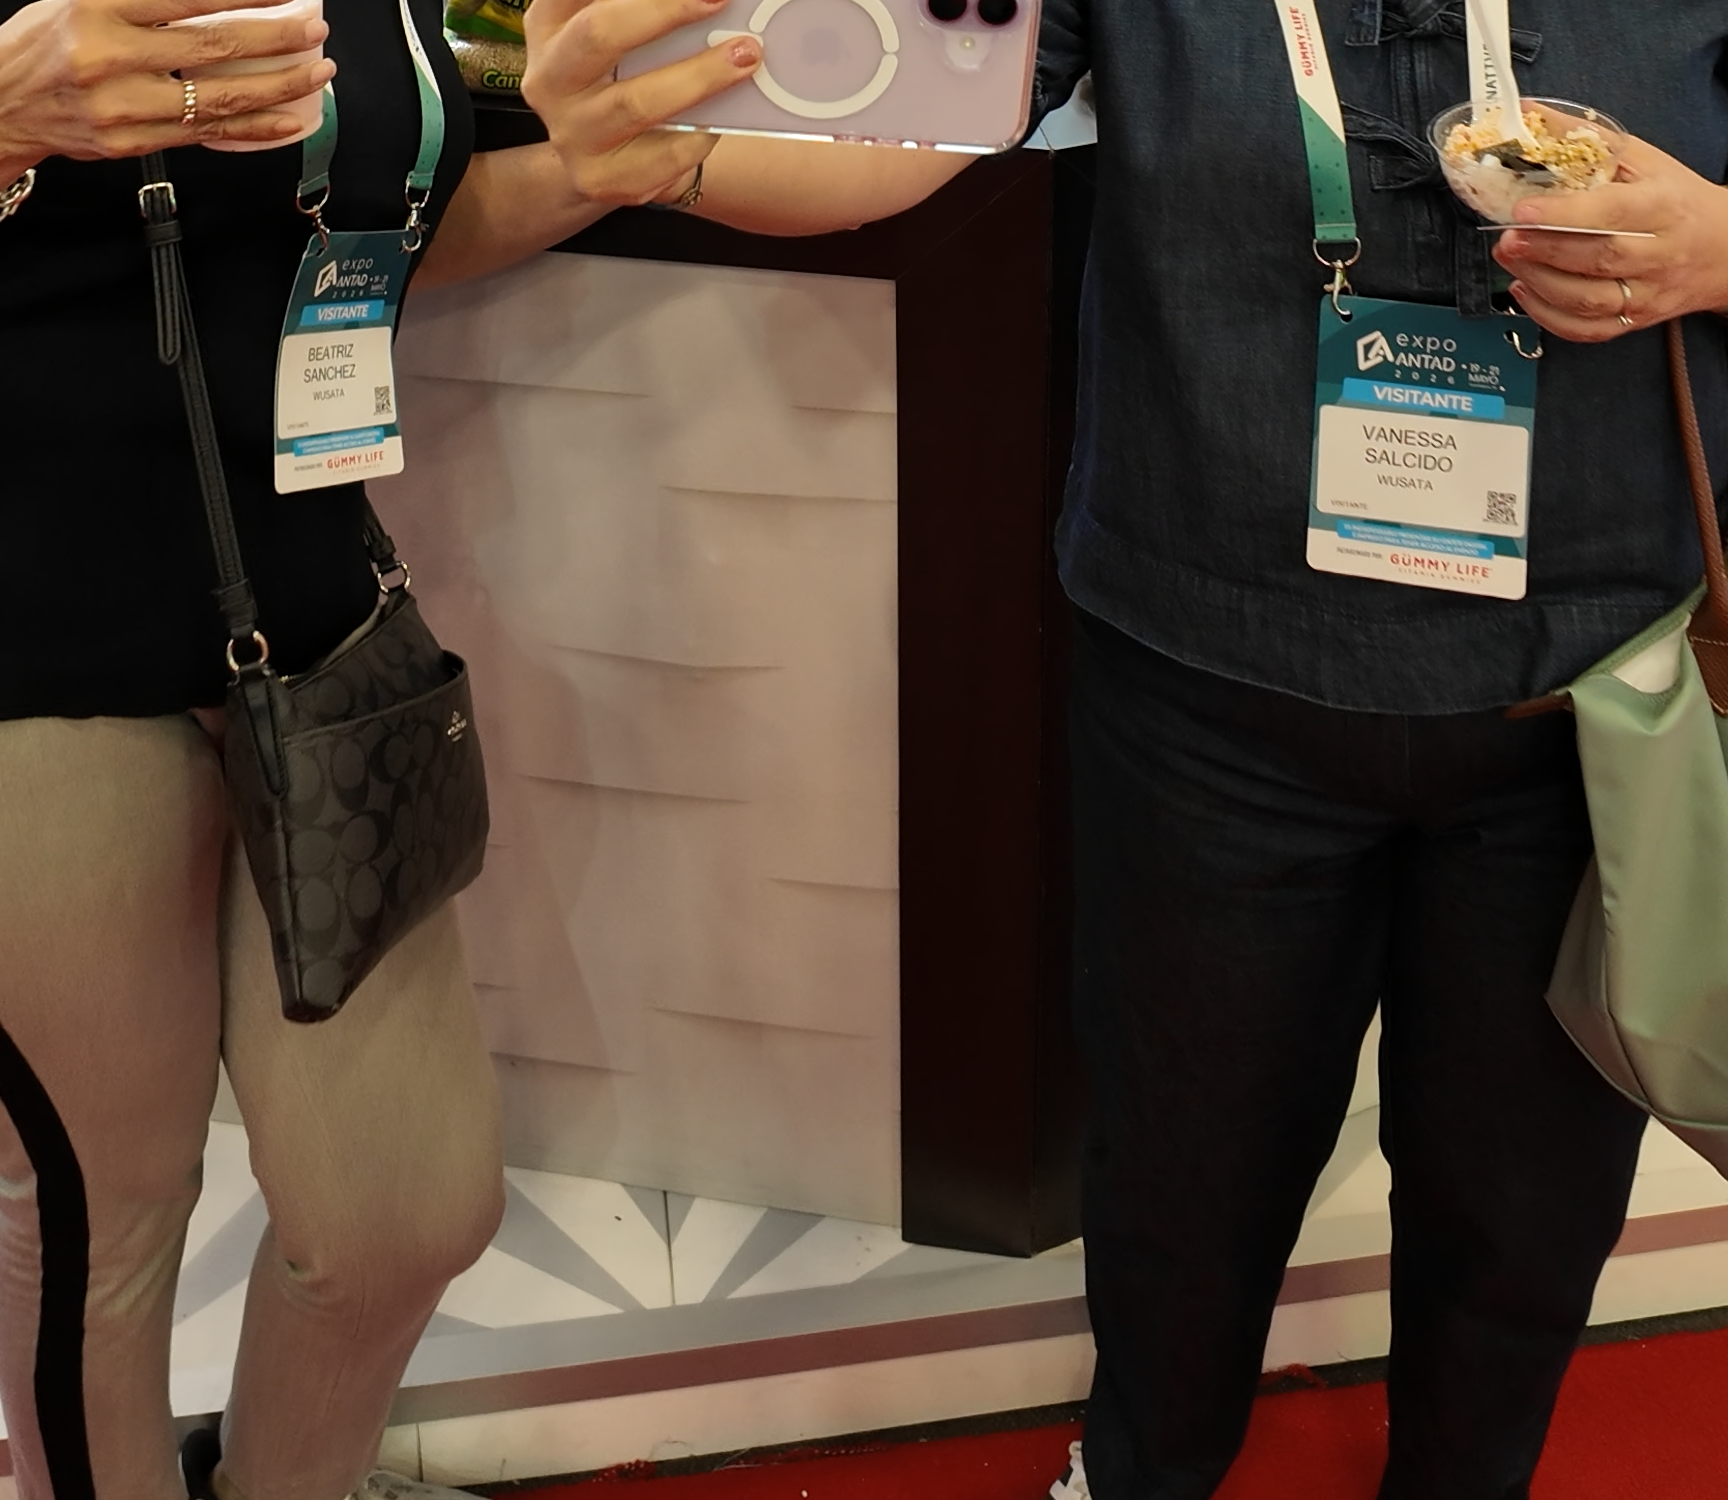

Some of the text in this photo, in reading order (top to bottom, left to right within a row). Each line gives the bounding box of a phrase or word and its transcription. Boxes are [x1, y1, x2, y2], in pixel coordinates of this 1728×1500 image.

[1289, 6, 1303, 30] LIFE
[342, 258, 374, 273] expo
[336, 274, 368, 287] ANTAD
[318, 304, 369, 321] VISITANTE
[1396, 333, 1457, 353] expo
[308, 343, 354, 362] BEATRIZ
[1395, 353, 1456, 372] ANTAD
[303, 363, 356, 383] SANCHEZ
[1468, 372, 1500, 386] MAYO
[313, 388, 345, 401] WUSATA
[1373, 385, 1474, 412] VISITANTE
[1362, 424, 1458, 451] VANESSA
[365, 450, 384, 463] LIFE
[1365, 447, 1454, 473] SALCIDO
[1377, 474, 1434, 491] WUSATA
[1456, 562, 1491, 578] LIFE
